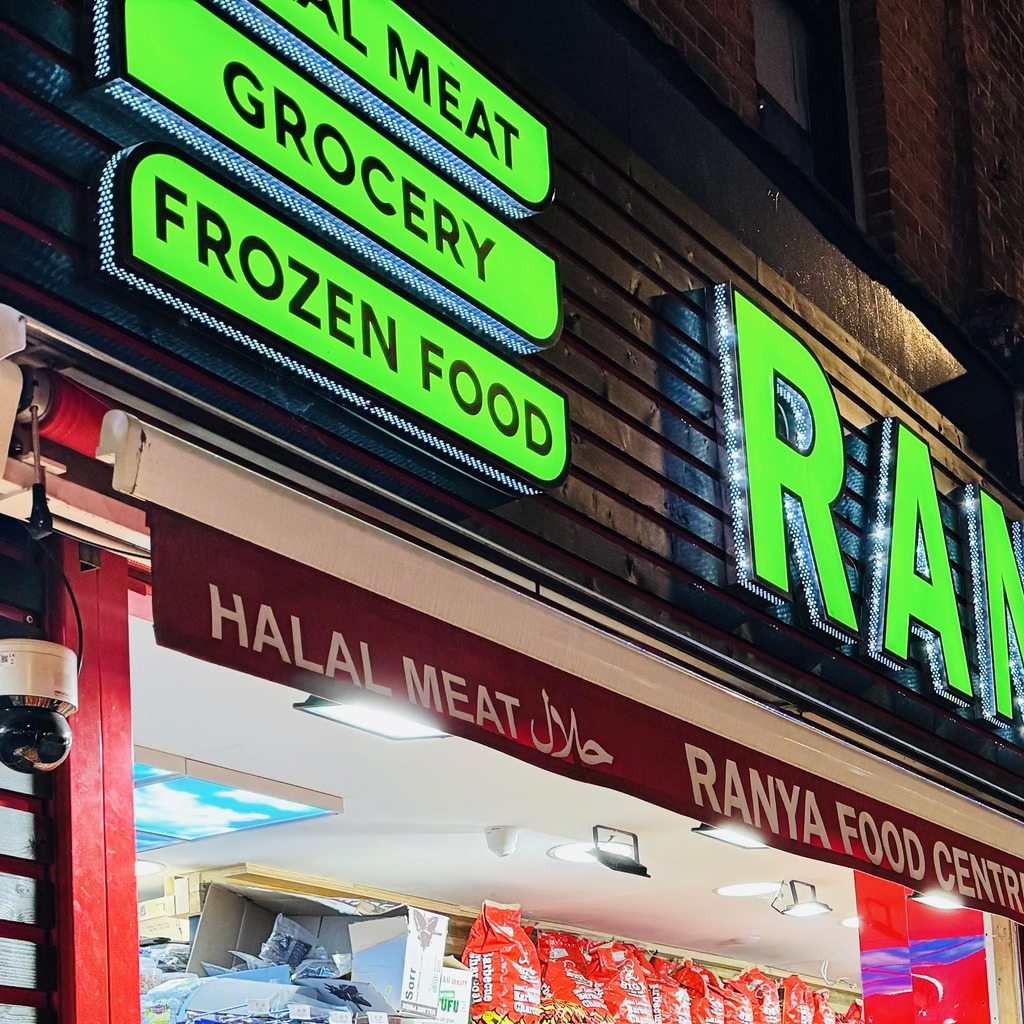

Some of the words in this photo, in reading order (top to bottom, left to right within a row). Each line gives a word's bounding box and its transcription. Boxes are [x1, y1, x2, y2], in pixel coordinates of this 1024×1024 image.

[223, 61, 495, 281] GROCERY
[387, 24, 519, 170] MEAT
[154, 177, 398, 374] FROZEN
[420, 336, 552, 457] FOOD
[209, 583, 392, 697] HALAL
[403, 656, 520, 739] MEAT
[684, 743, 831, 849] RANYA
[836, 801, 925, 881] FOOD
[440, 999, 459, 1013] UFU
